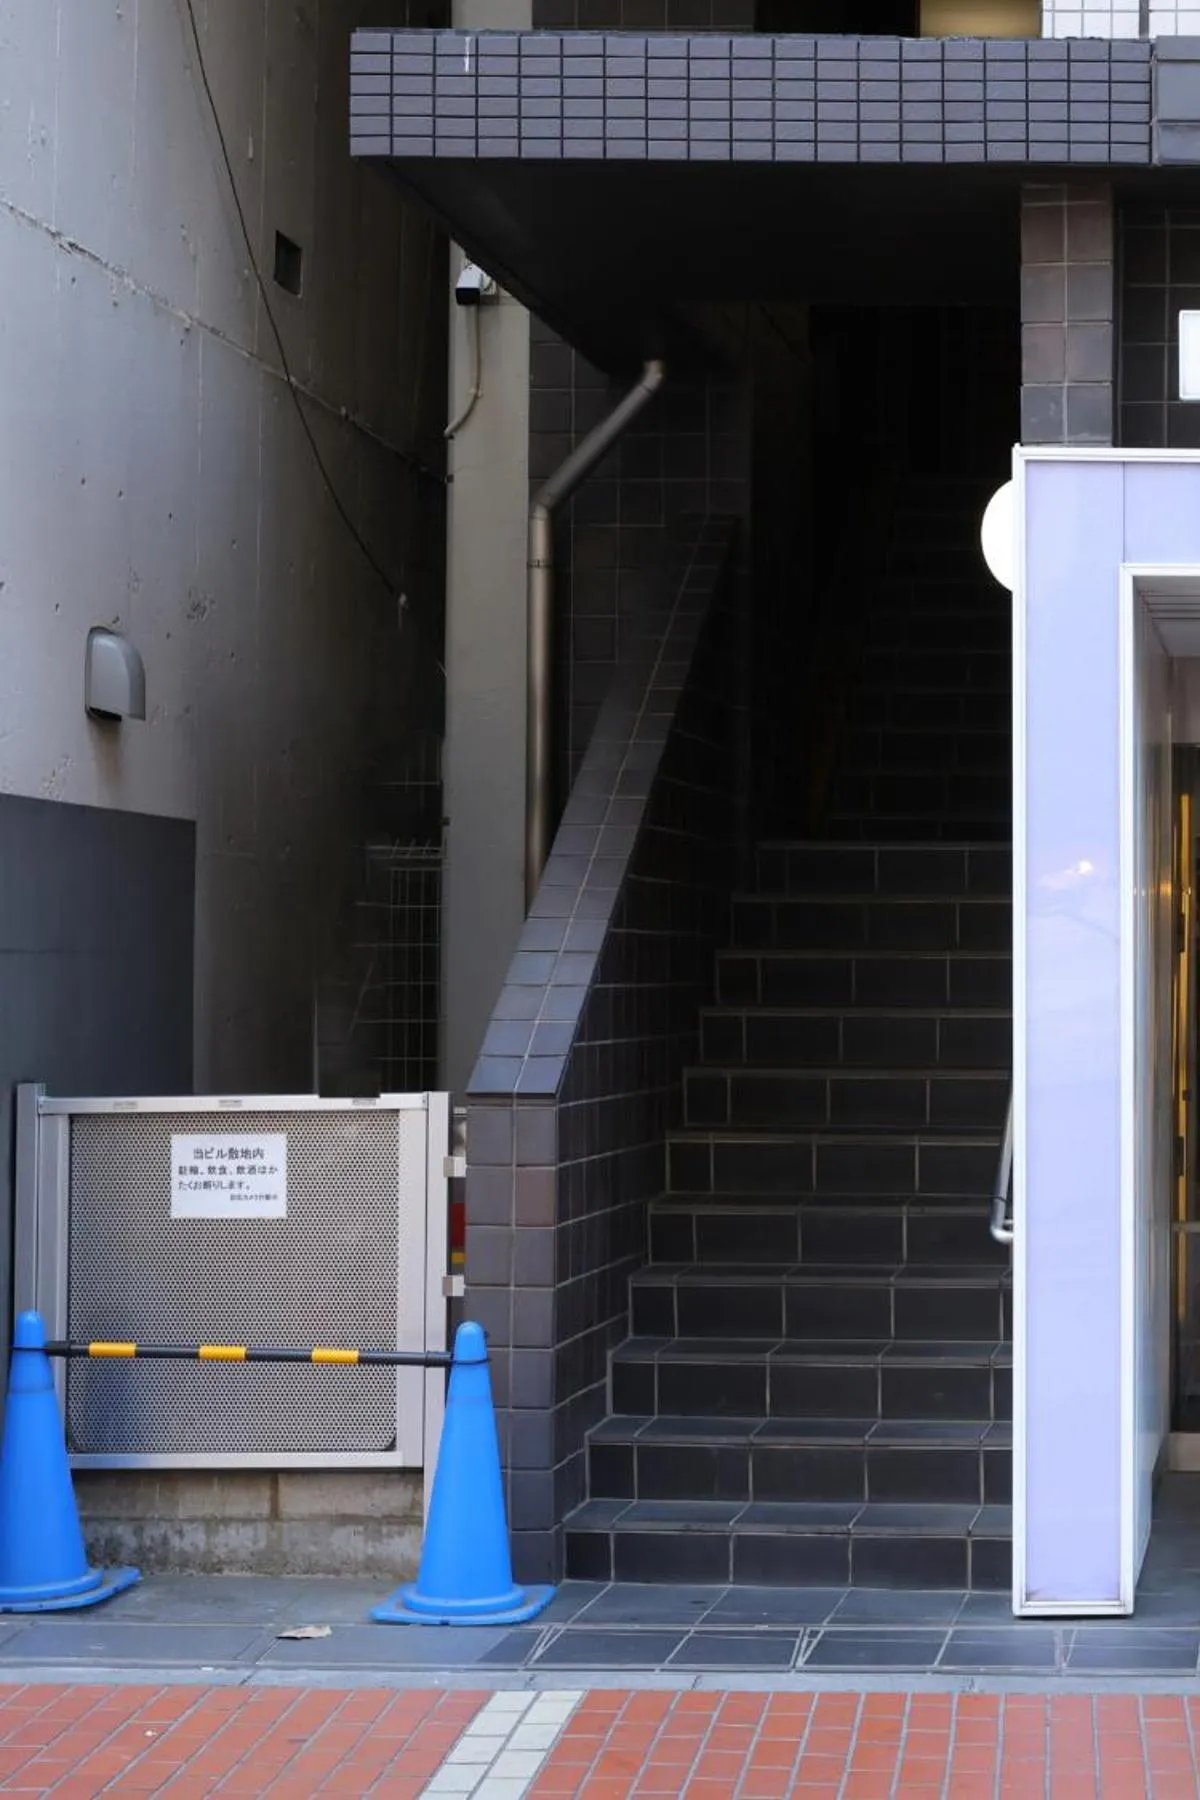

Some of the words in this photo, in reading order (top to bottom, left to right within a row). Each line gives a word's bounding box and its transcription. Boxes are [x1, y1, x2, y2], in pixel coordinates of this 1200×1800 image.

[193, 1147, 265, 1160] 当ビル敷地内
